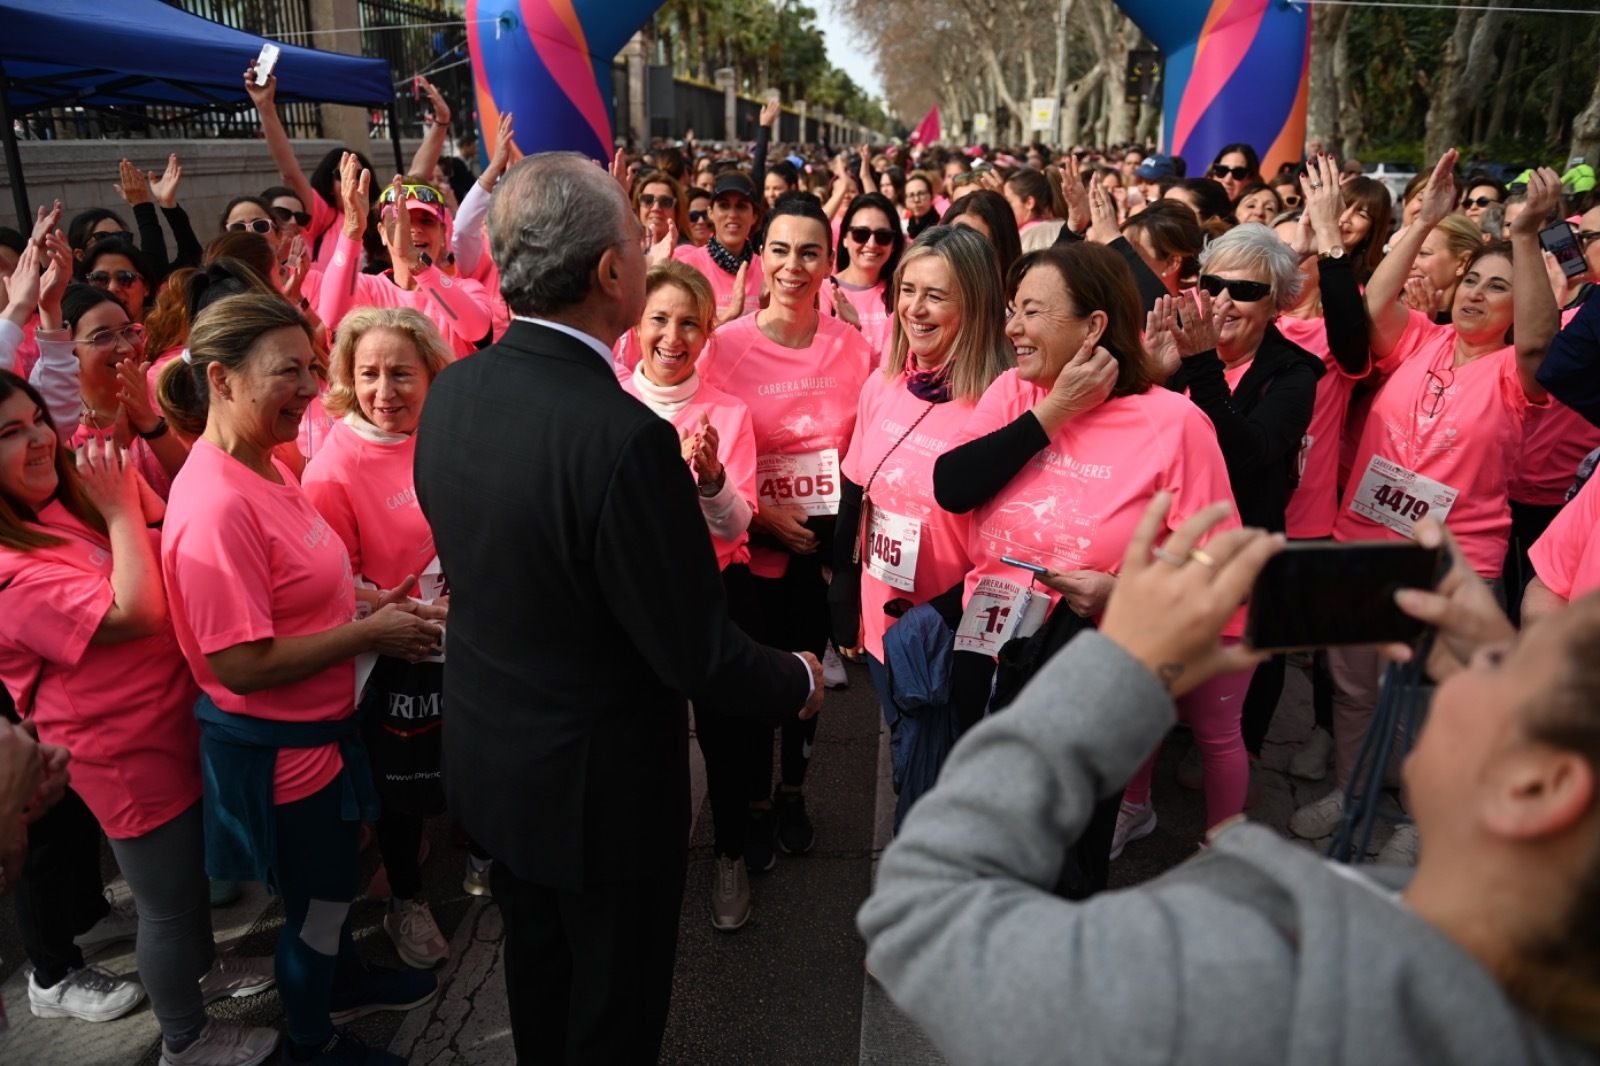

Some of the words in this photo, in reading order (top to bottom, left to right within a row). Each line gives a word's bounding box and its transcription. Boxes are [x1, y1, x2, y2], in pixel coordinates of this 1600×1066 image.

[758, 381, 799, 396] CARRERA
[801, 376, 838, 391] MUJERES
[1063, 453, 1114, 481] MUJERES
[760, 474, 834, 499] 4505
[1374, 484, 1430, 522] 4479
